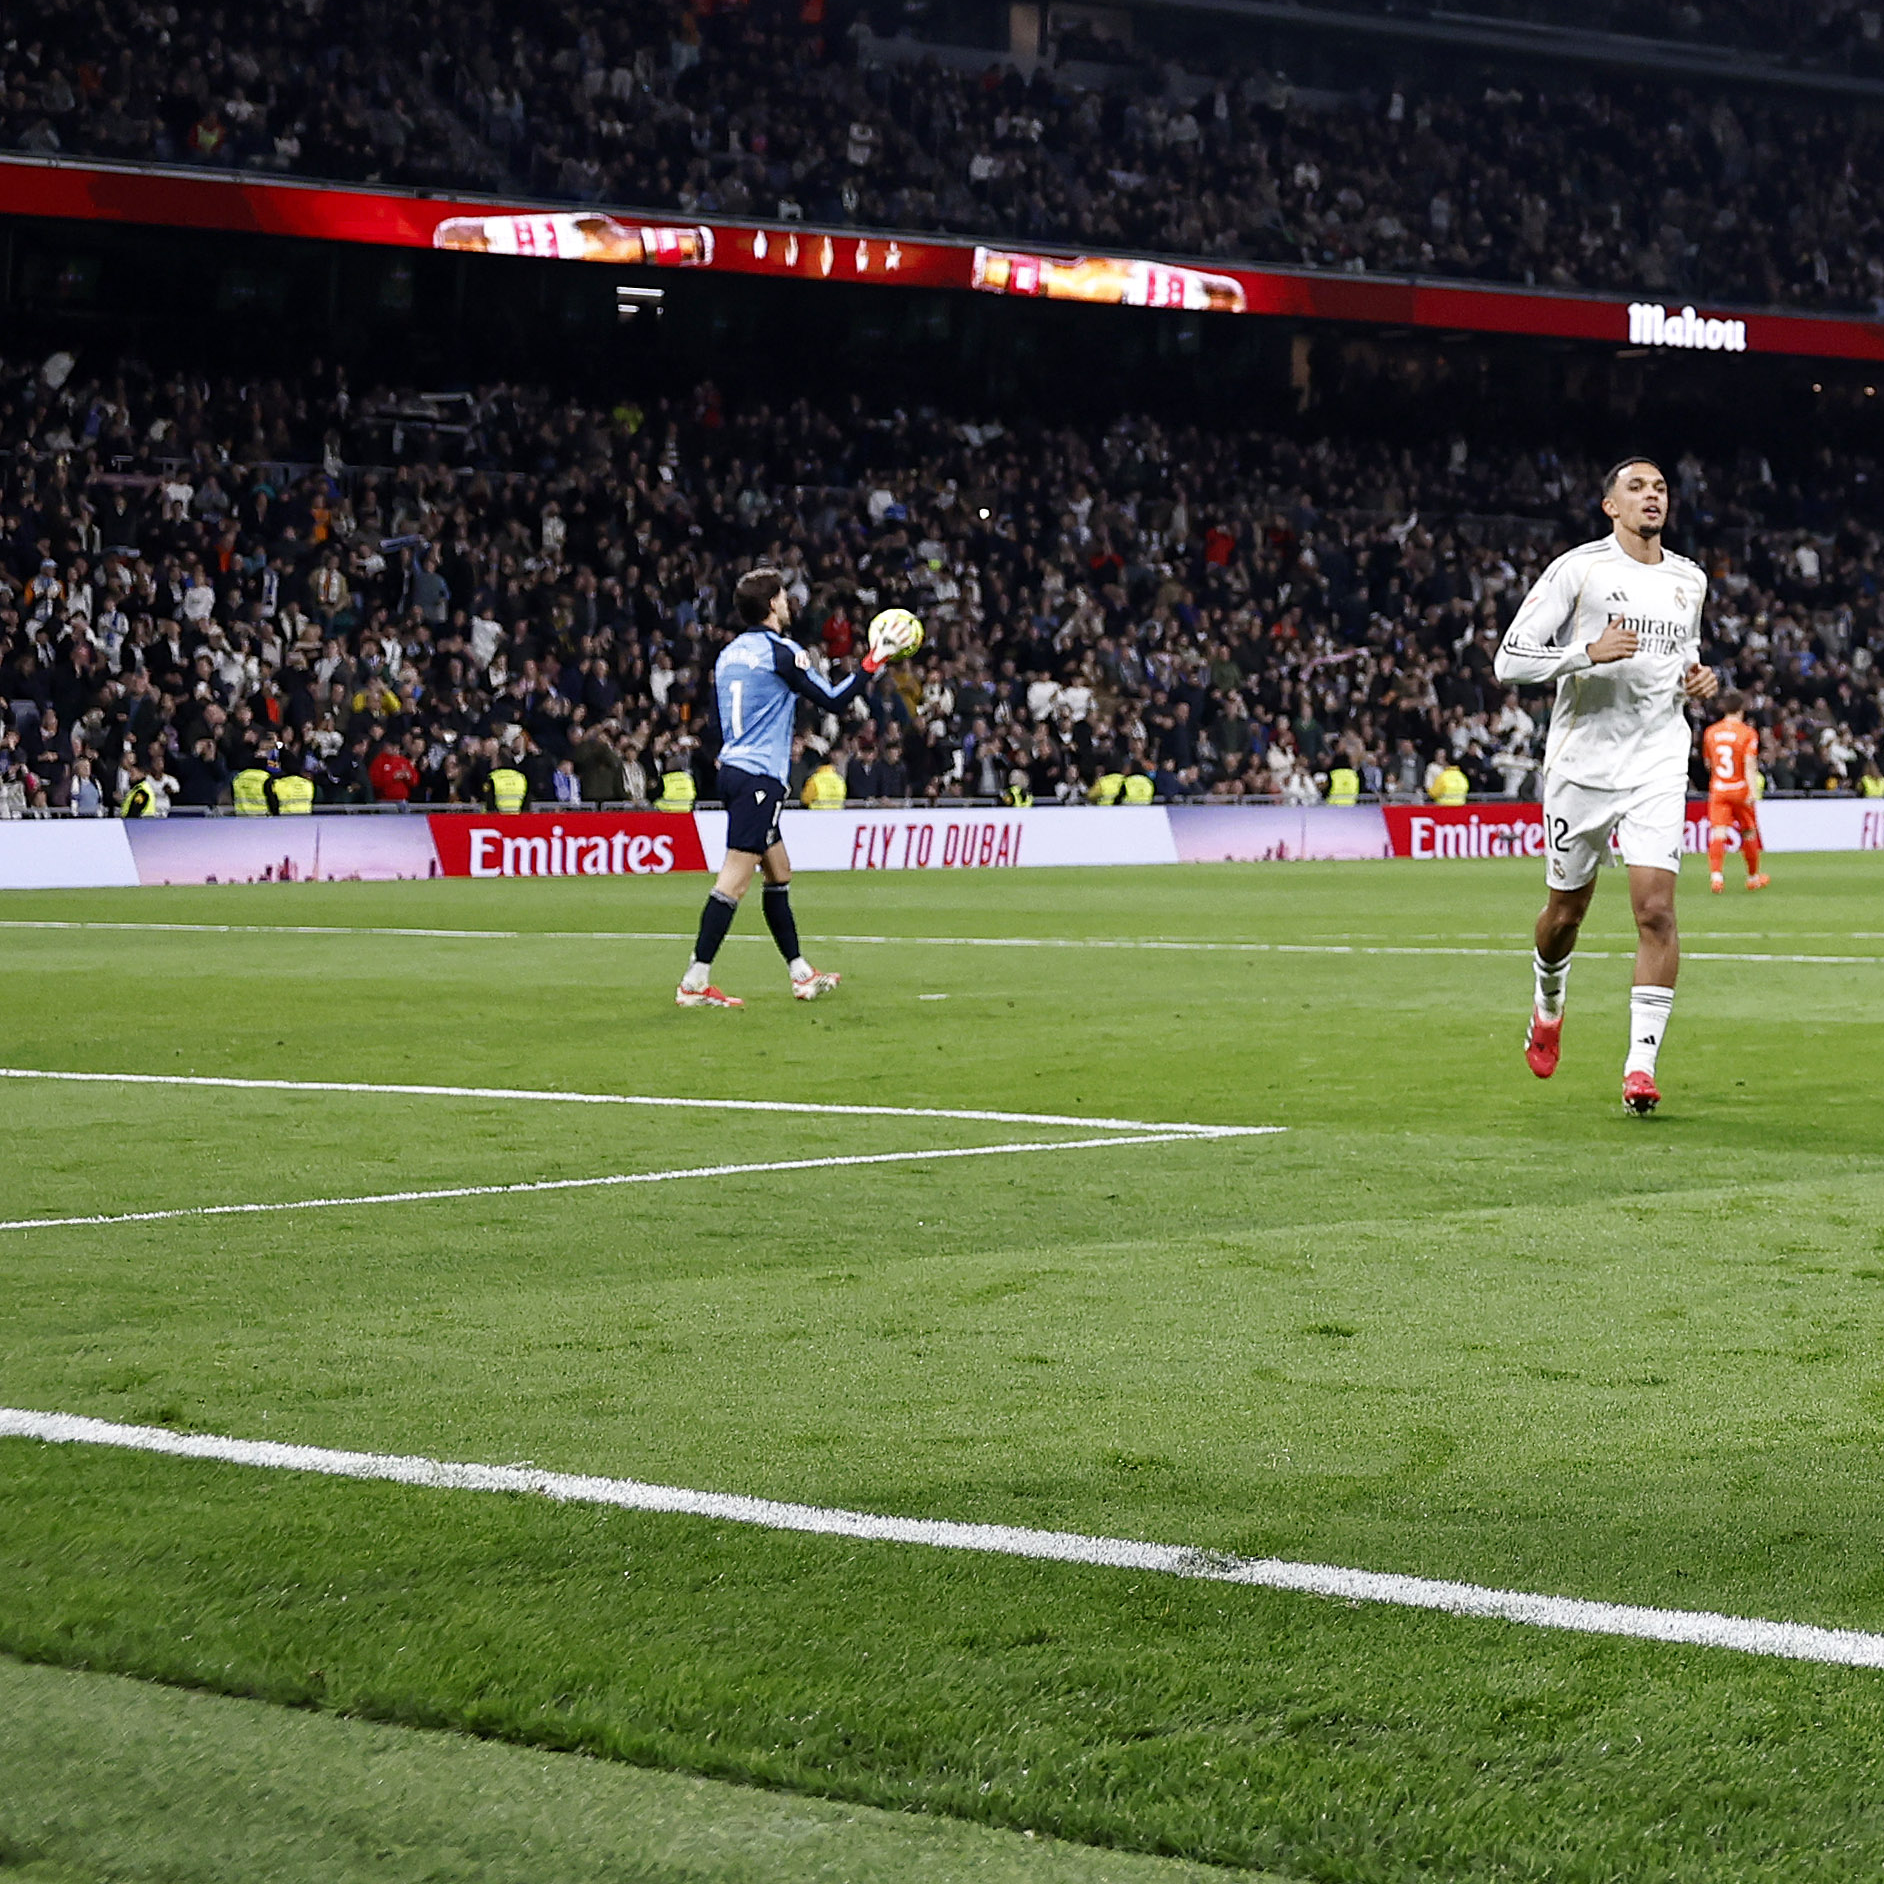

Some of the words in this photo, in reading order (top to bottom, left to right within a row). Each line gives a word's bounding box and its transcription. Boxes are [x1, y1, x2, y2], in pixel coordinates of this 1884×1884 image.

[1627, 302, 1747, 352] Mahou
[729, 679, 745, 740] 1
[1715, 744, 1735, 779] 3
[469, 825, 675, 878] Emirates
[851, 823, 897, 869] FLY
[904, 823, 934, 869] TO
[943, 822, 1023, 868] DUBAI
[1410, 814, 1545, 860] Emirate
[1546, 813, 1571, 853] 12
